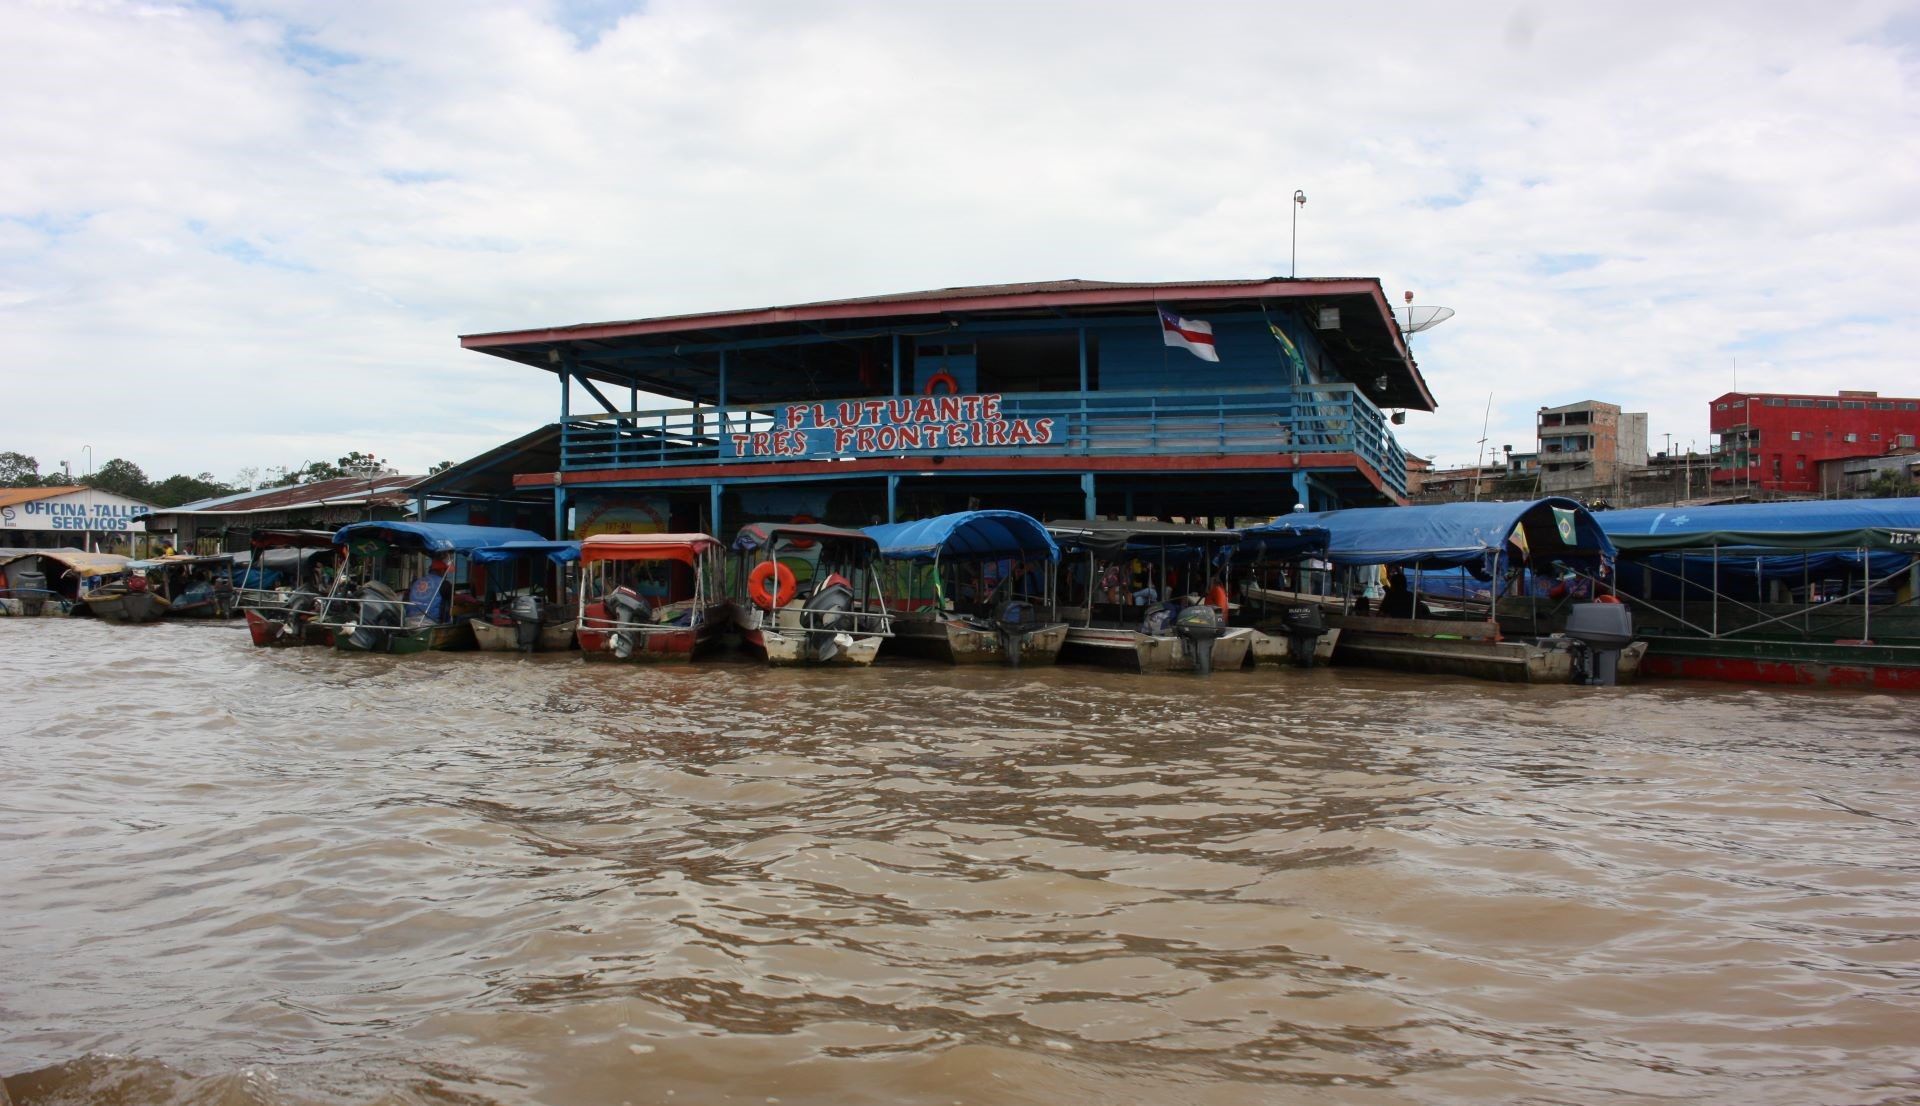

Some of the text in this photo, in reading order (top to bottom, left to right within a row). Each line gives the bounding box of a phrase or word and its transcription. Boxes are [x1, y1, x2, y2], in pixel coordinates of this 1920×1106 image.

[785, 394, 1002, 430] FLUTUANTE
[834, 418, 1055, 452] FRONTEIRAS
[52, 517, 128, 530] SERVICOS
